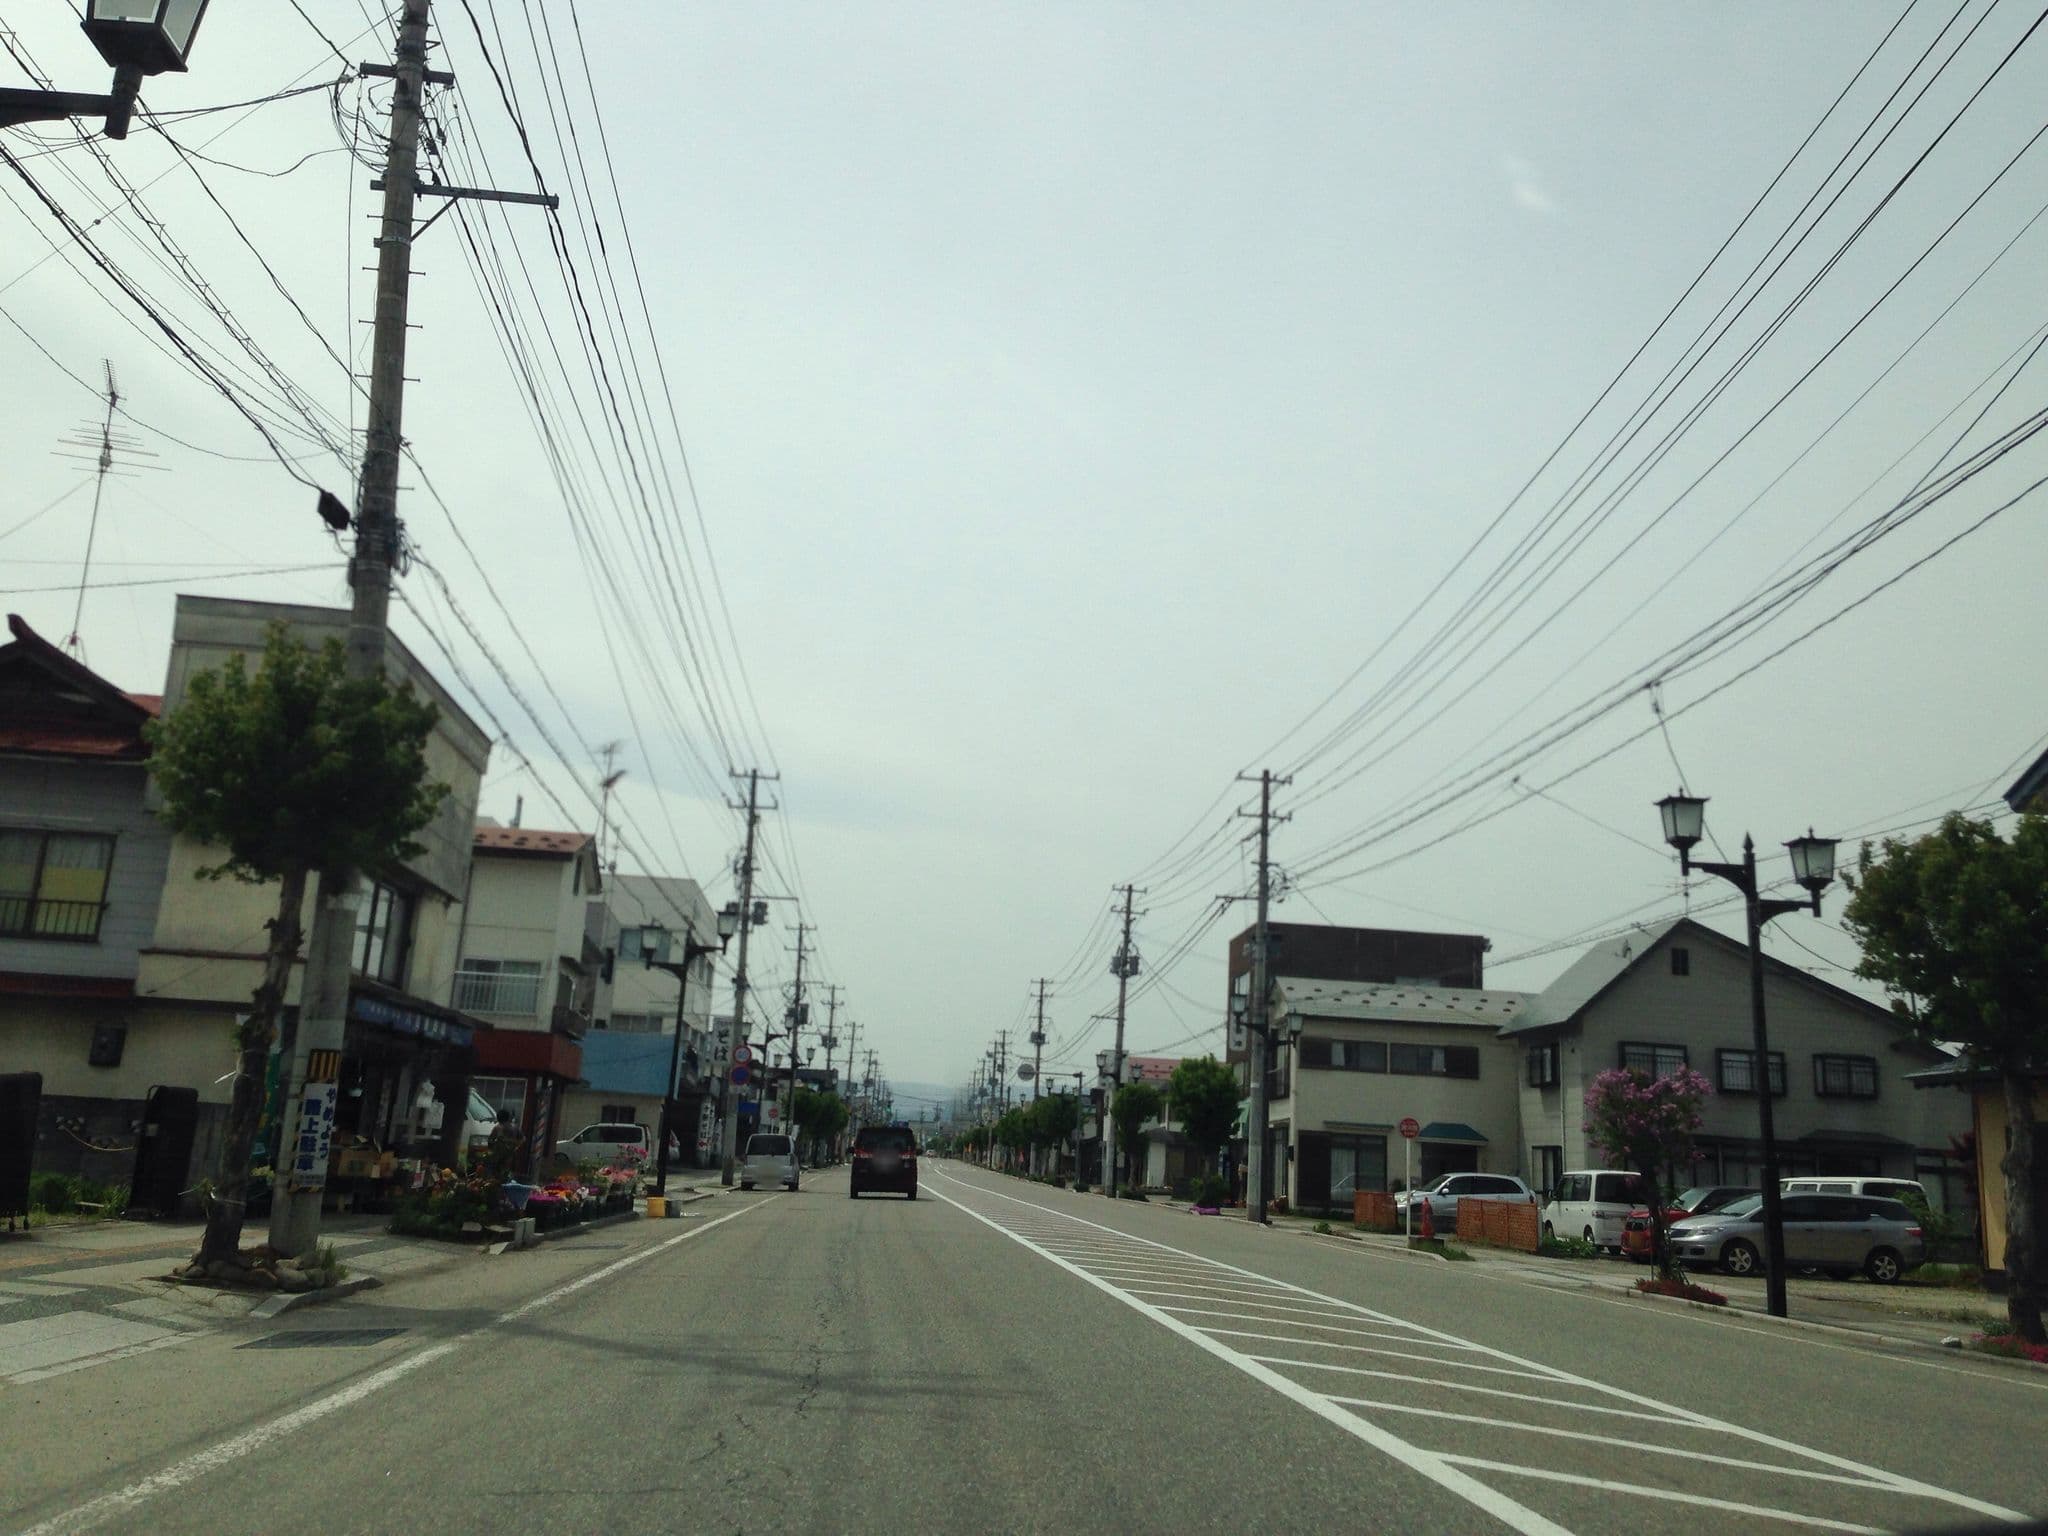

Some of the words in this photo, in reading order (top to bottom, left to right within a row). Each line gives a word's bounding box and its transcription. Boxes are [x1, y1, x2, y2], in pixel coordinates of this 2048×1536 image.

[713, 1029, 730, 1062] そば
[296, 1099, 322, 1171] 路上駐車
[319, 1087, 337, 1159] やめよう
